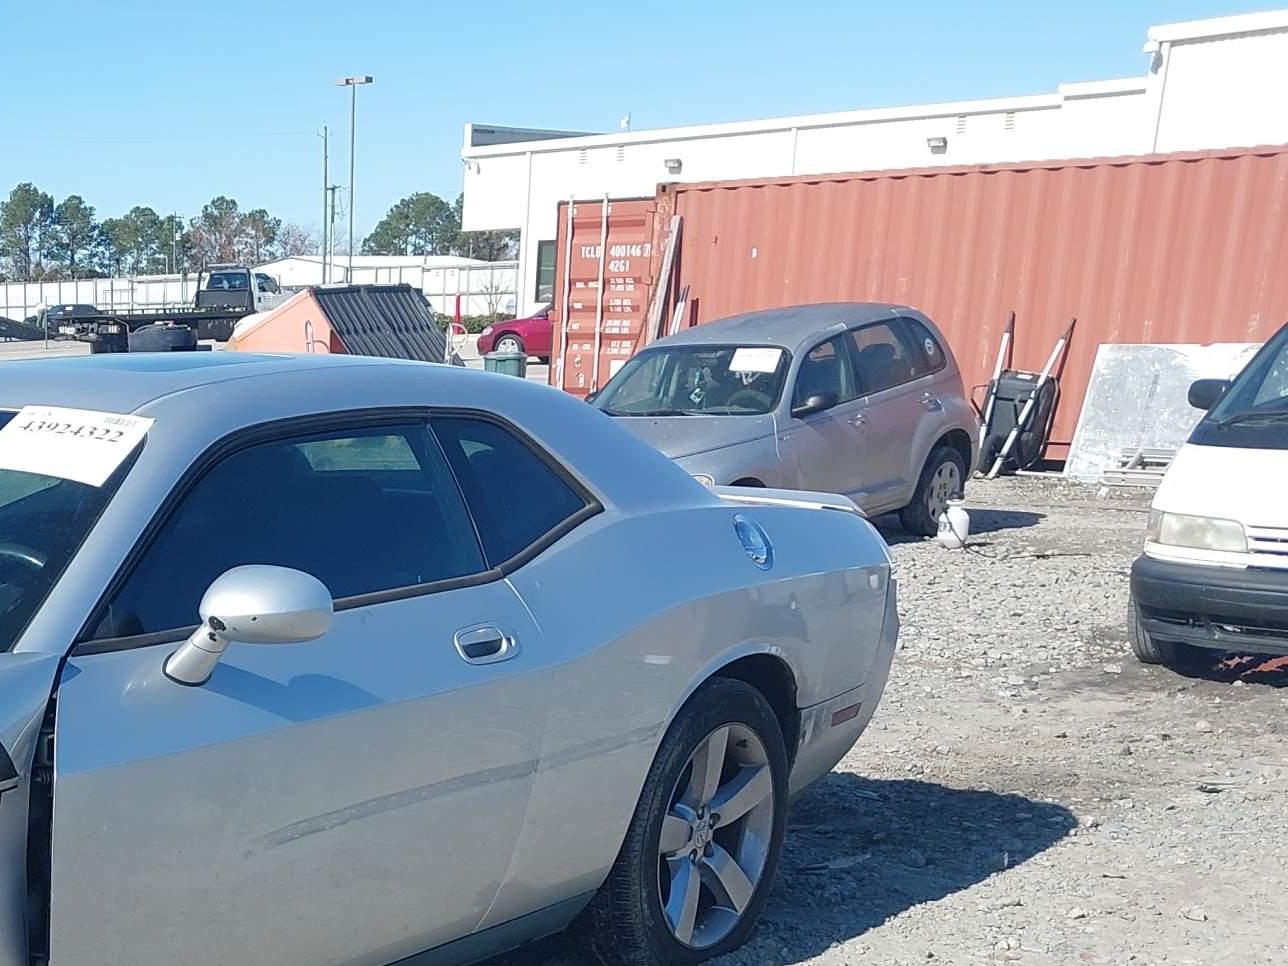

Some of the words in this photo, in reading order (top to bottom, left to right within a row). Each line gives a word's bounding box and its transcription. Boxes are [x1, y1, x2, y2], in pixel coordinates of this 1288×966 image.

[609, 244, 641, 257] 400146
[608, 259, 630, 272] 42G1
[19, 420, 124, 442] 43924322
